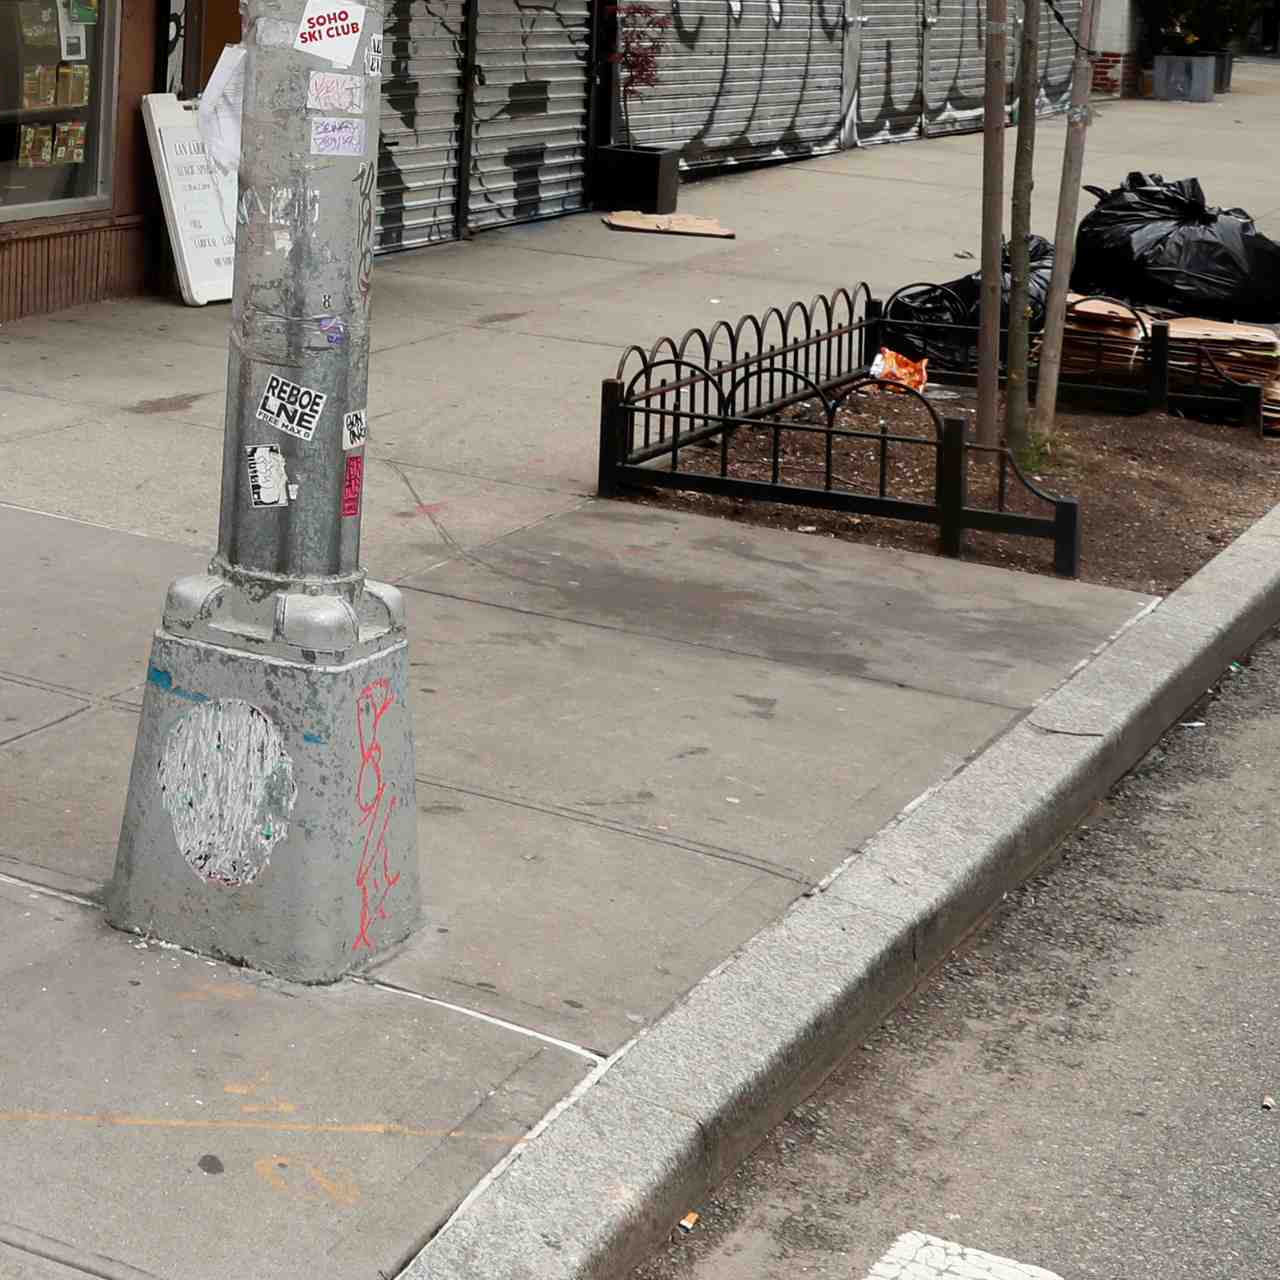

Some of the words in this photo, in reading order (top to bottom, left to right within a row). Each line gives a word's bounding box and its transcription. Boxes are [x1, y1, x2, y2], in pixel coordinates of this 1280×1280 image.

[307, 10, 349, 29] SOHO
[300, 30, 322, 43] SKI
[327, 22, 360, 38] CLUB
